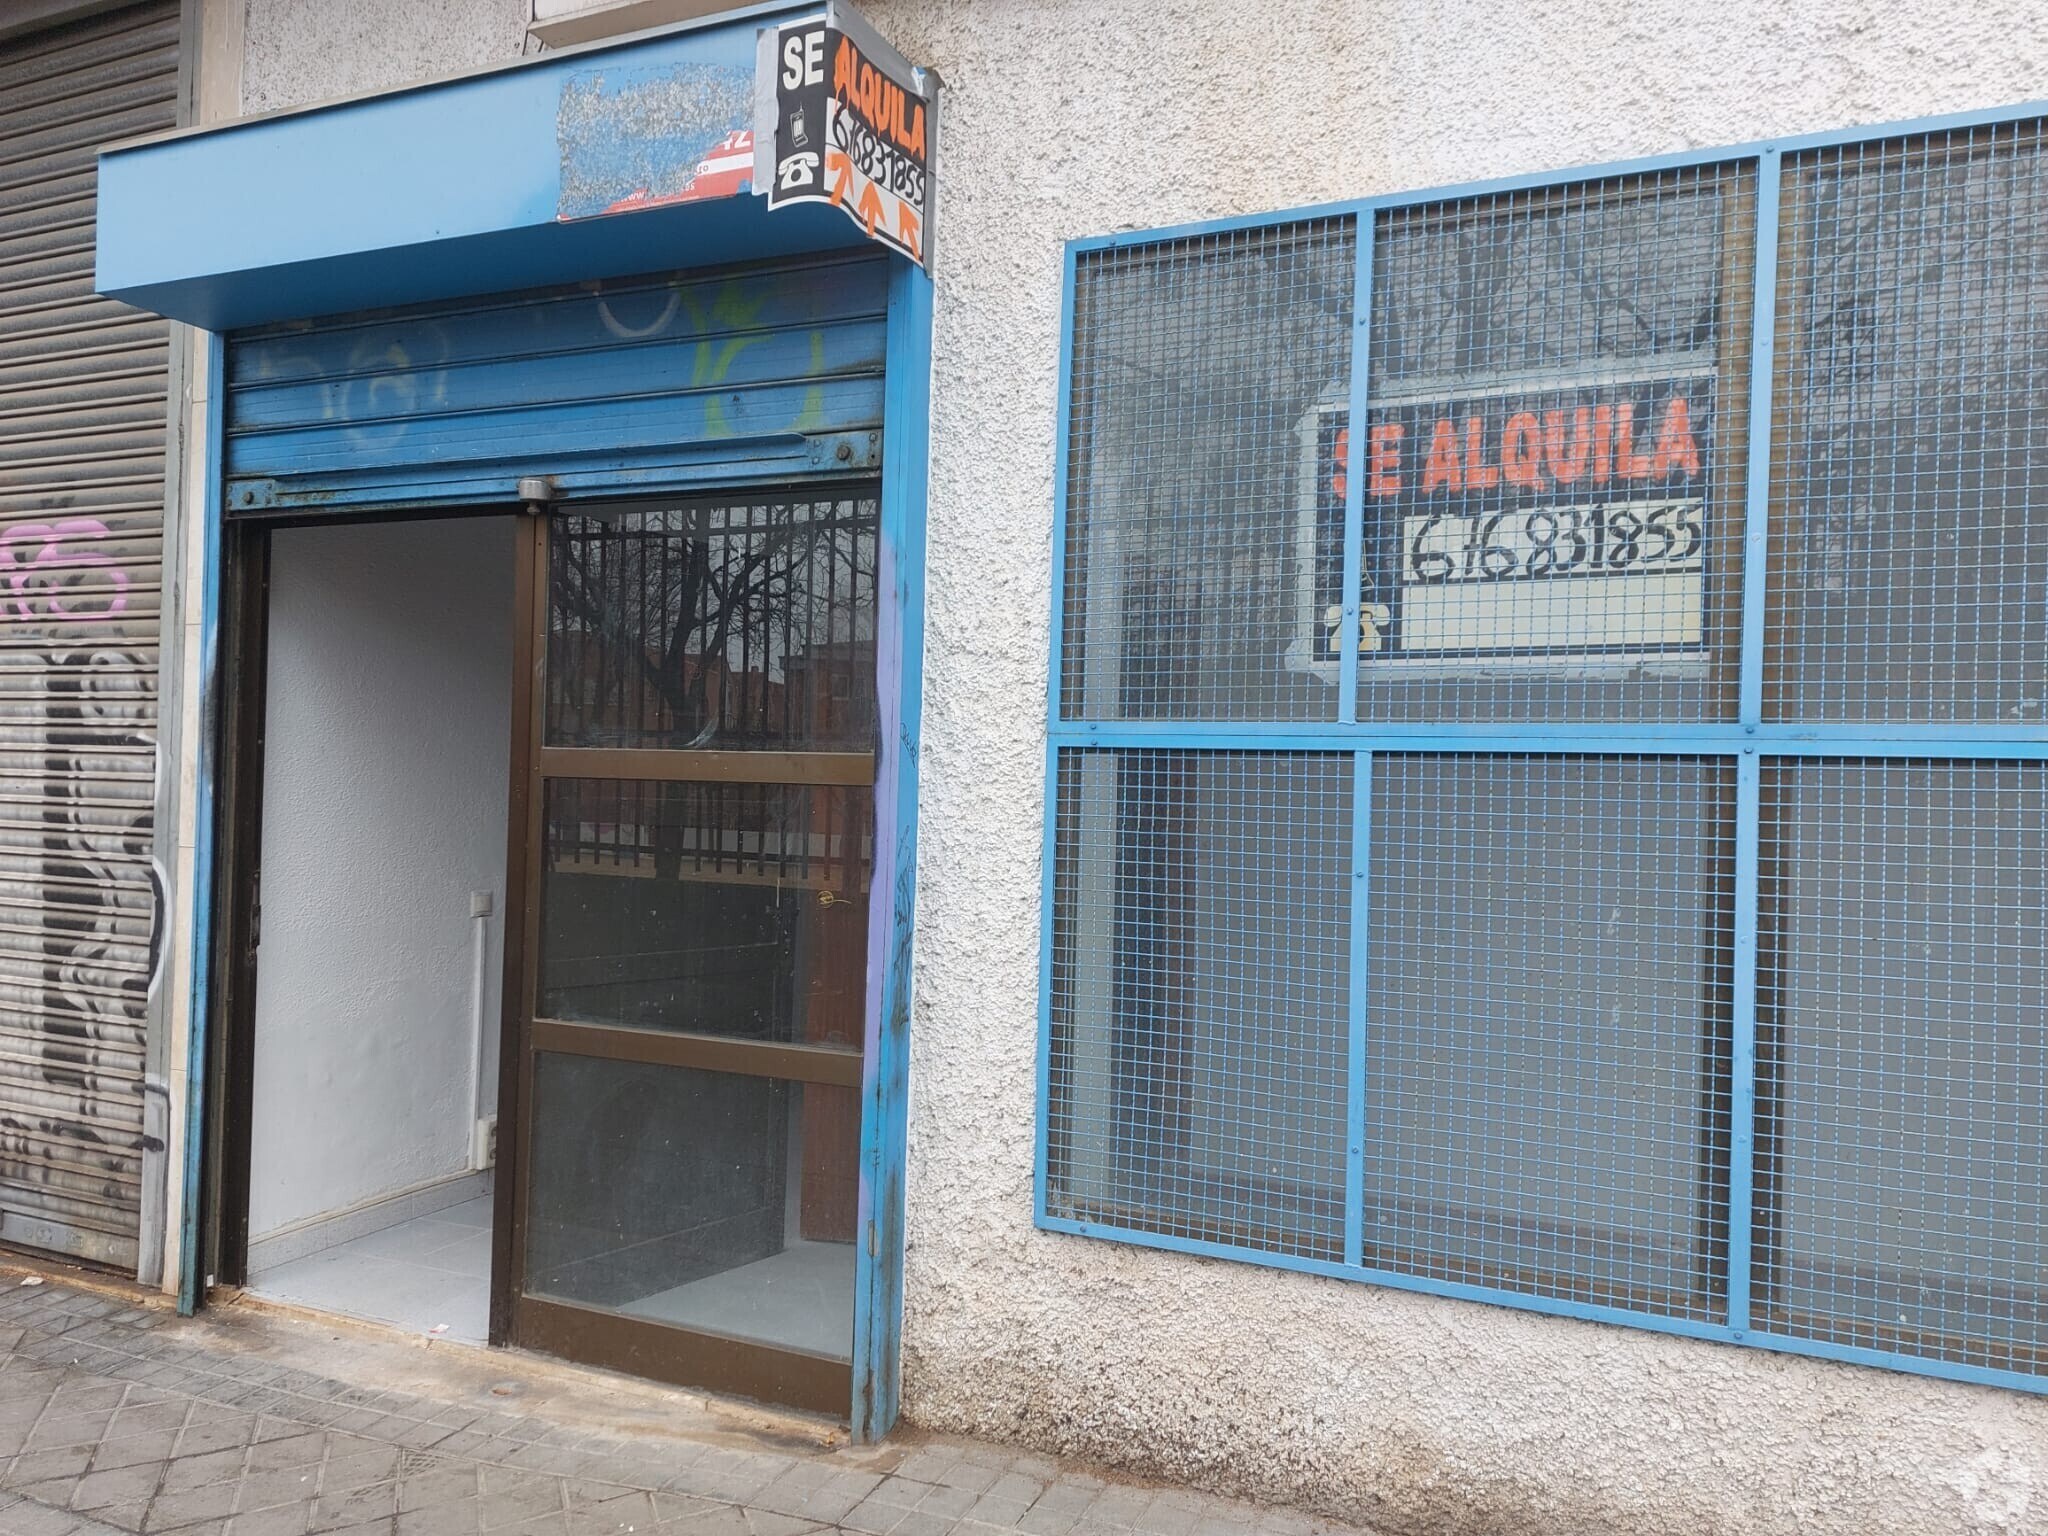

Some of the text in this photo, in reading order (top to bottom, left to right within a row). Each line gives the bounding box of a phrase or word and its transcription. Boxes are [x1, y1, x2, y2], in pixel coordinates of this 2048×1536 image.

[783, 31, 925, 161] SE ALQUILA
[1421, 398, 1700, 494] ALQUILA
